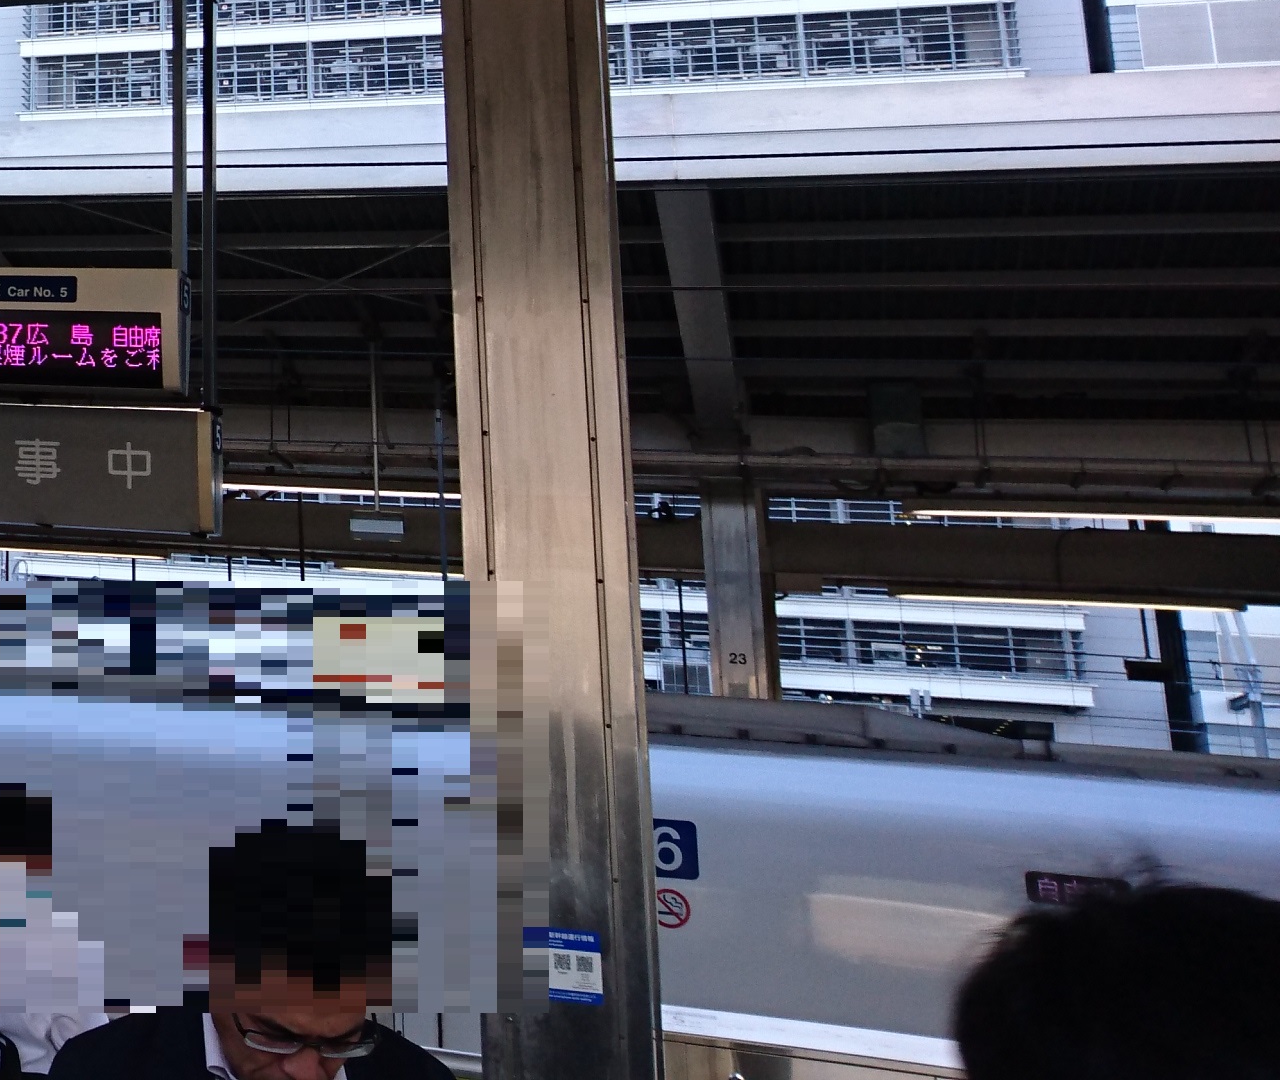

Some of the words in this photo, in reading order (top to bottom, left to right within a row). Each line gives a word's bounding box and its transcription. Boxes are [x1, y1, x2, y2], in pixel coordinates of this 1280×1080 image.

[7, 286, 30, 298] Car
[33, 286, 55, 298] No.
[59, 287, 68, 298] 5
[214, 425, 222, 450] 5
[729, 652, 747, 665] 23
[653, 826, 683, 871] 6
